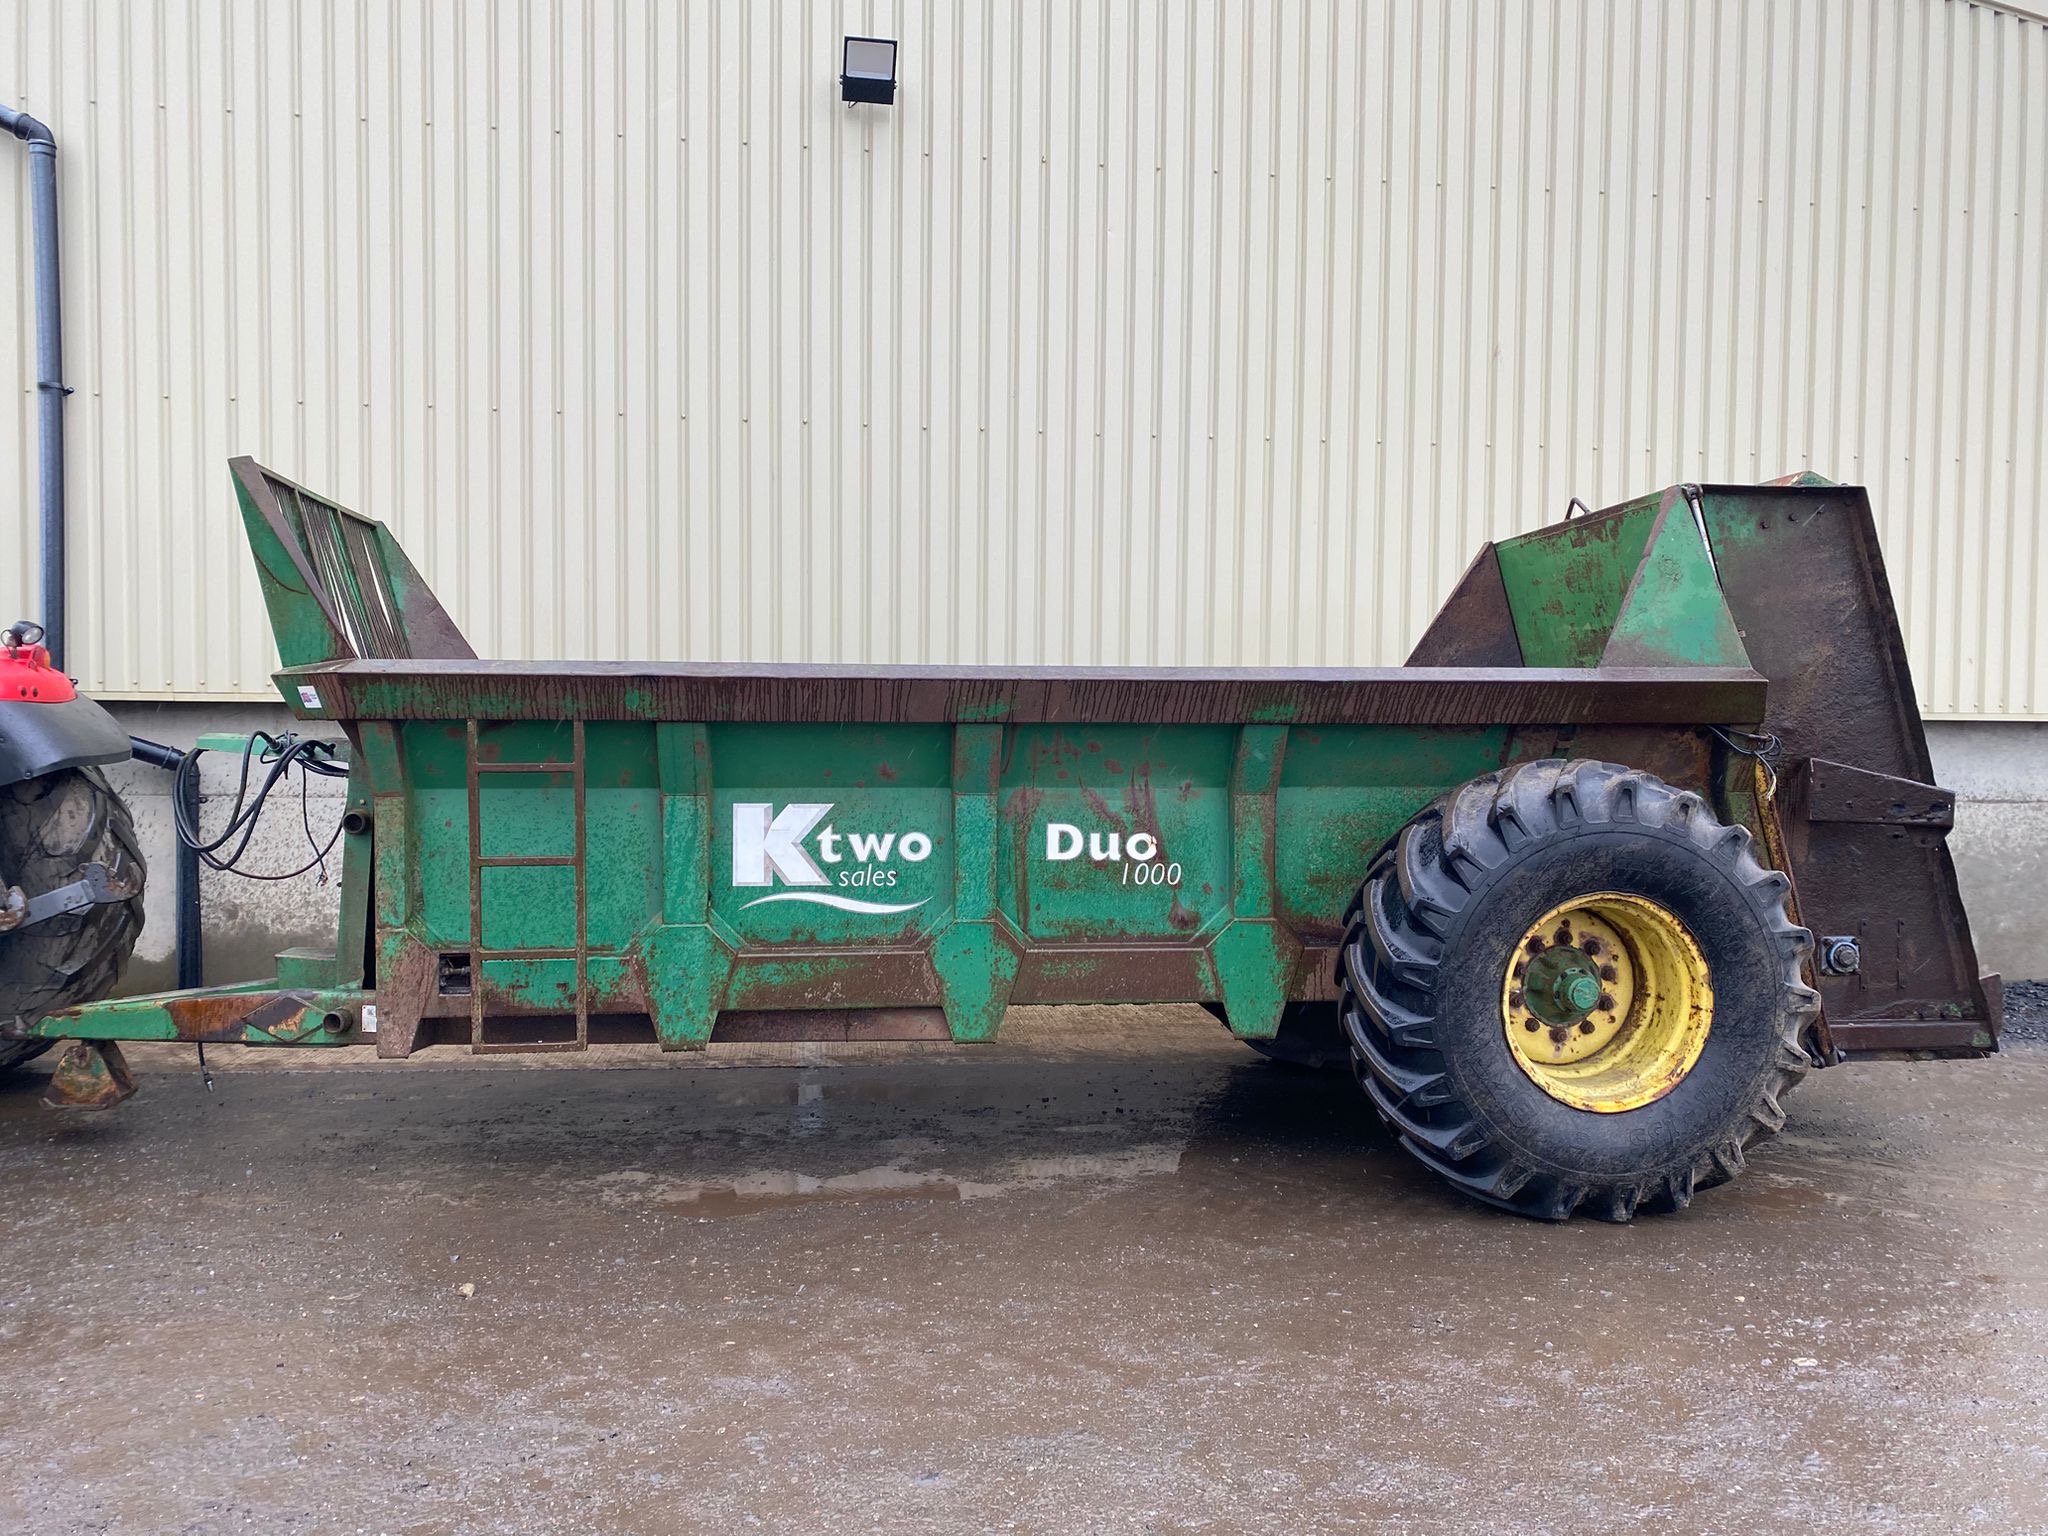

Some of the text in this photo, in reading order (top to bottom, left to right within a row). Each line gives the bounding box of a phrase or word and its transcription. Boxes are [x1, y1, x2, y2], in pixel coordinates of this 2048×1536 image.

[1046, 822, 1158, 861] Duo
[838, 863, 897, 887] sales
[1121, 862, 1182, 885] 1000
